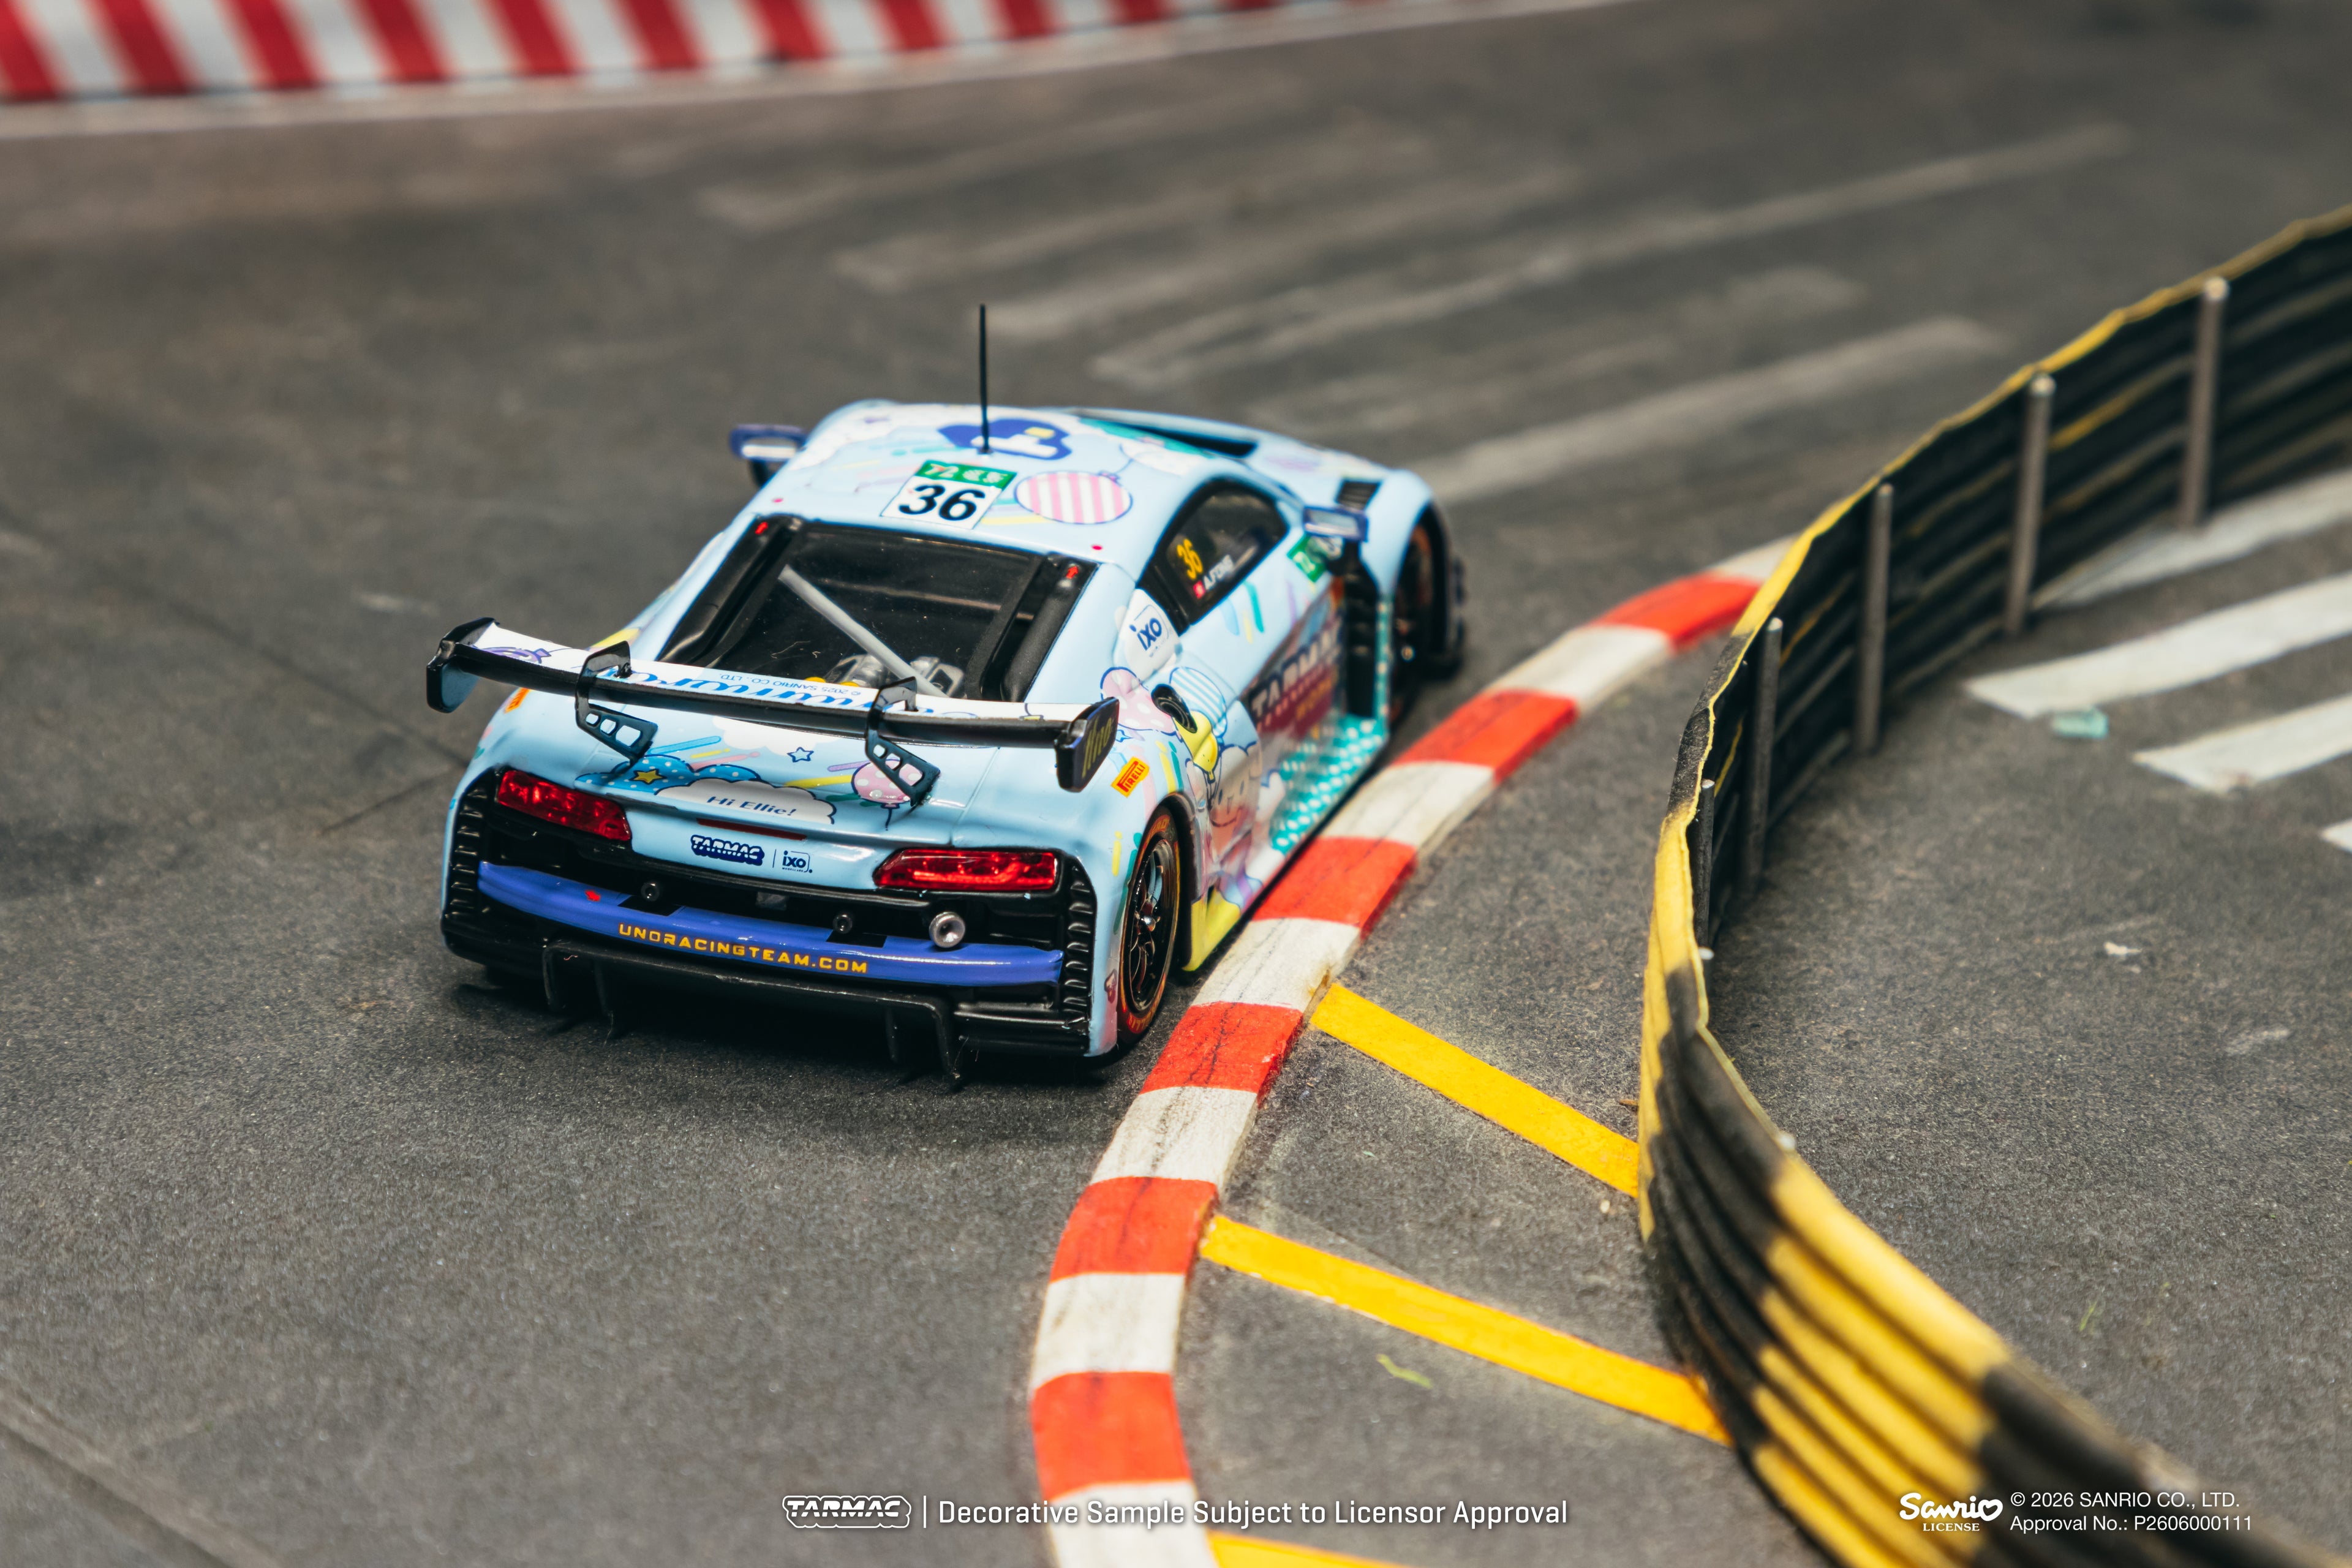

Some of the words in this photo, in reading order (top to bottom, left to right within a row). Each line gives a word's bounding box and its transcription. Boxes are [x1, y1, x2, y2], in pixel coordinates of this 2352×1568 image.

[898, 484, 986, 521] 36
[1177, 538, 1203, 579] 36
[773, 680, 818, 691] SANRIO
[1116, 760, 1146, 793] PIRELLI
[707, 796, 736, 806] Hi
[739, 801, 797, 816] Ellie!
[692, 836, 761, 860] TARMAC
[619, 923, 868, 974] UNORACINGTEAM.COM
